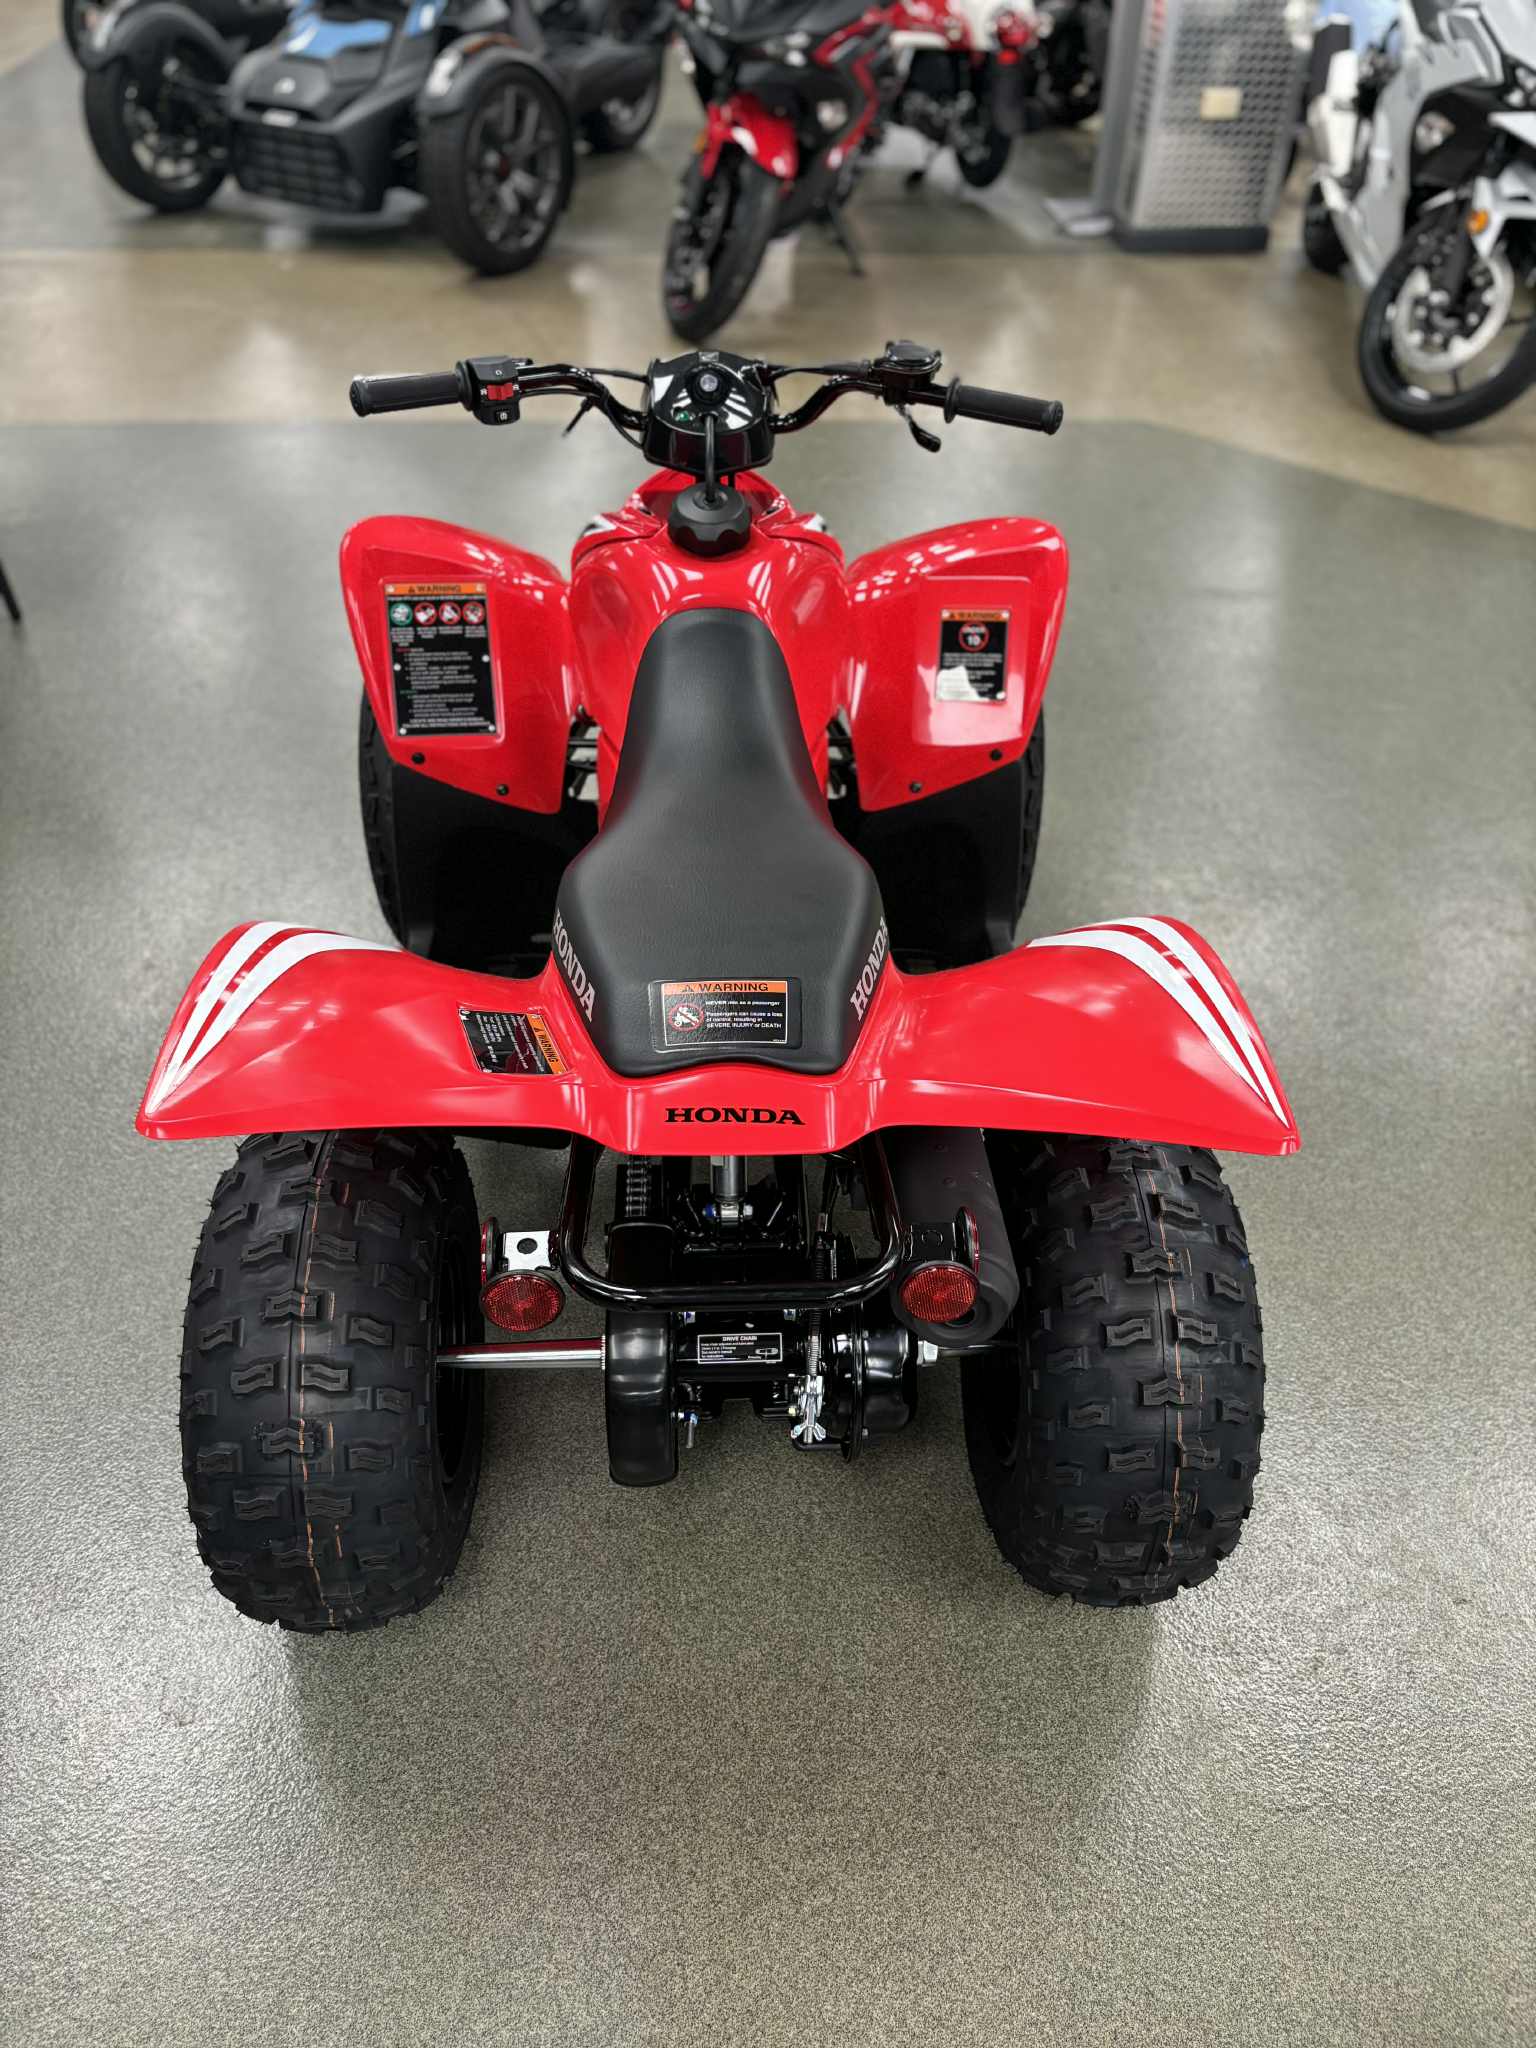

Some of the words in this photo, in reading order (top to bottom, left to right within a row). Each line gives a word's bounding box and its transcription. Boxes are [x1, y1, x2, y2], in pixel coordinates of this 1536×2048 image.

[417, 584, 461, 592] WARNING
[552, 907, 596, 1022] HONDA
[850, 916, 888, 1021] HONDA
[698, 983, 769, 992] WARNING
[538, 1034, 559, 1063] WARNING
[664, 1107, 806, 1125] HONDA
